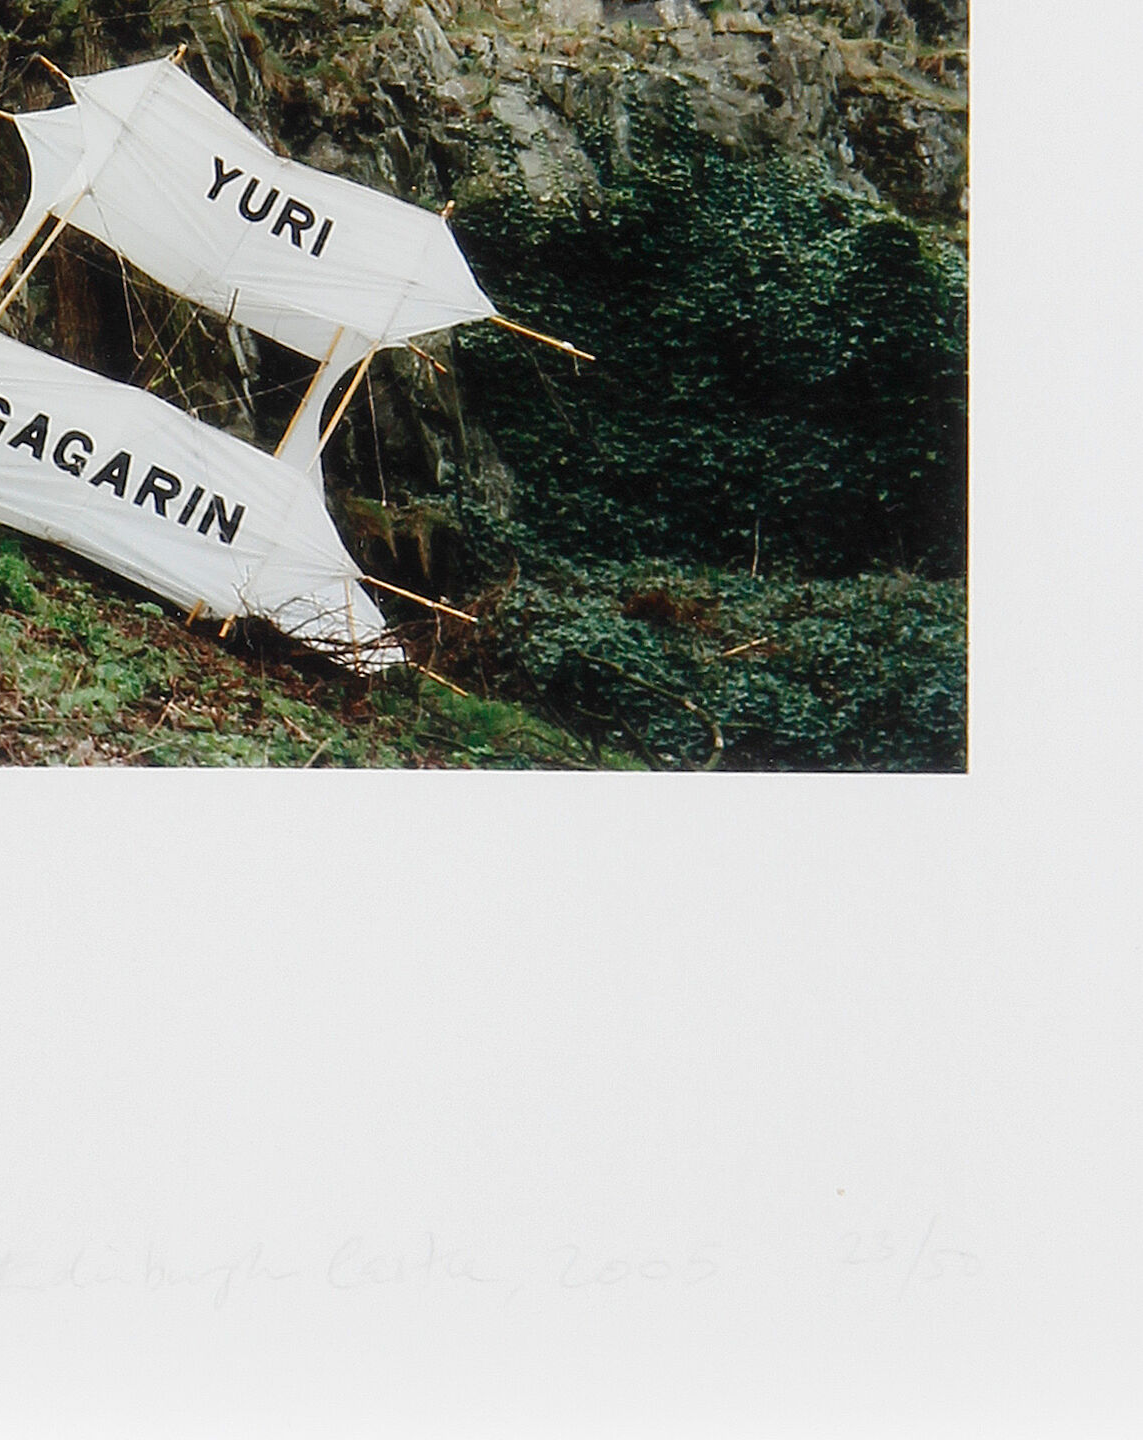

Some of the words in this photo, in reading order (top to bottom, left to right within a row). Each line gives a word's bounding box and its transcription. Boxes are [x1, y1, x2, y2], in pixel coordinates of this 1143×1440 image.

[205, 155, 335, 259] YURI
[557, 1241, 722, 1290] 2005
[837, 1213, 984, 1302] 23/50
